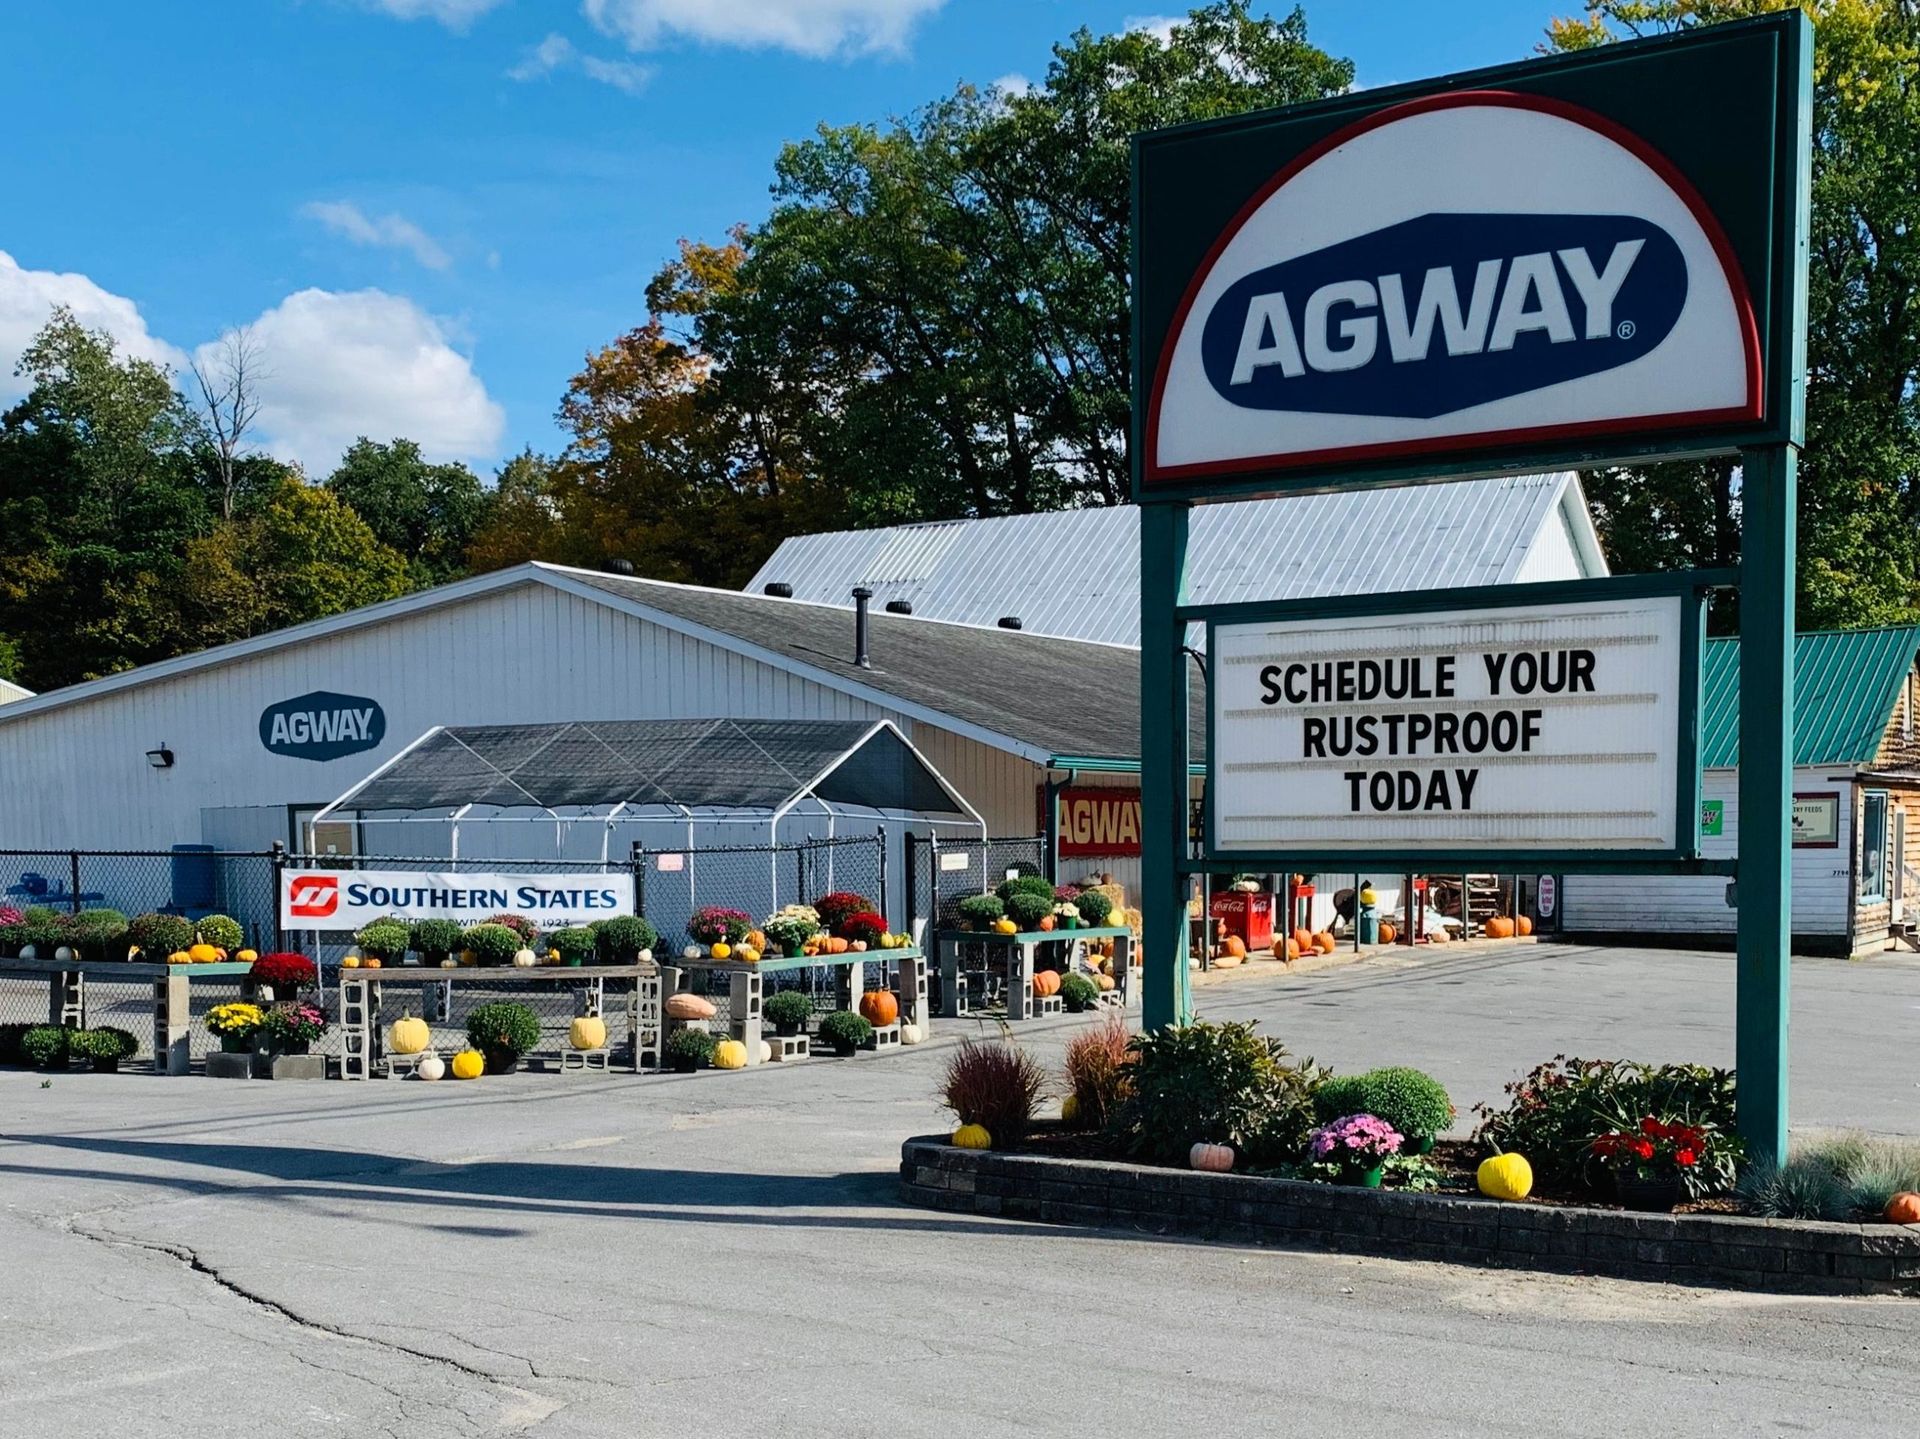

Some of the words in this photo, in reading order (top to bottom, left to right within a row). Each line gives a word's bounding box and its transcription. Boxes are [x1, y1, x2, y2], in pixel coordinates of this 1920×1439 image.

[1230, 239, 1646, 385] AGWAY
[1260, 656, 1455, 705] SCHEDULE
[1483, 650, 1596, 695] YOUR
[270, 707, 374, 745] AGWAY
[1303, 710, 1542, 758] RUSTPROOF
[1344, 769, 1479, 812] TODAY
[348, 883, 507, 908] SOUTHERN
[517, 886, 617, 909] STATES
